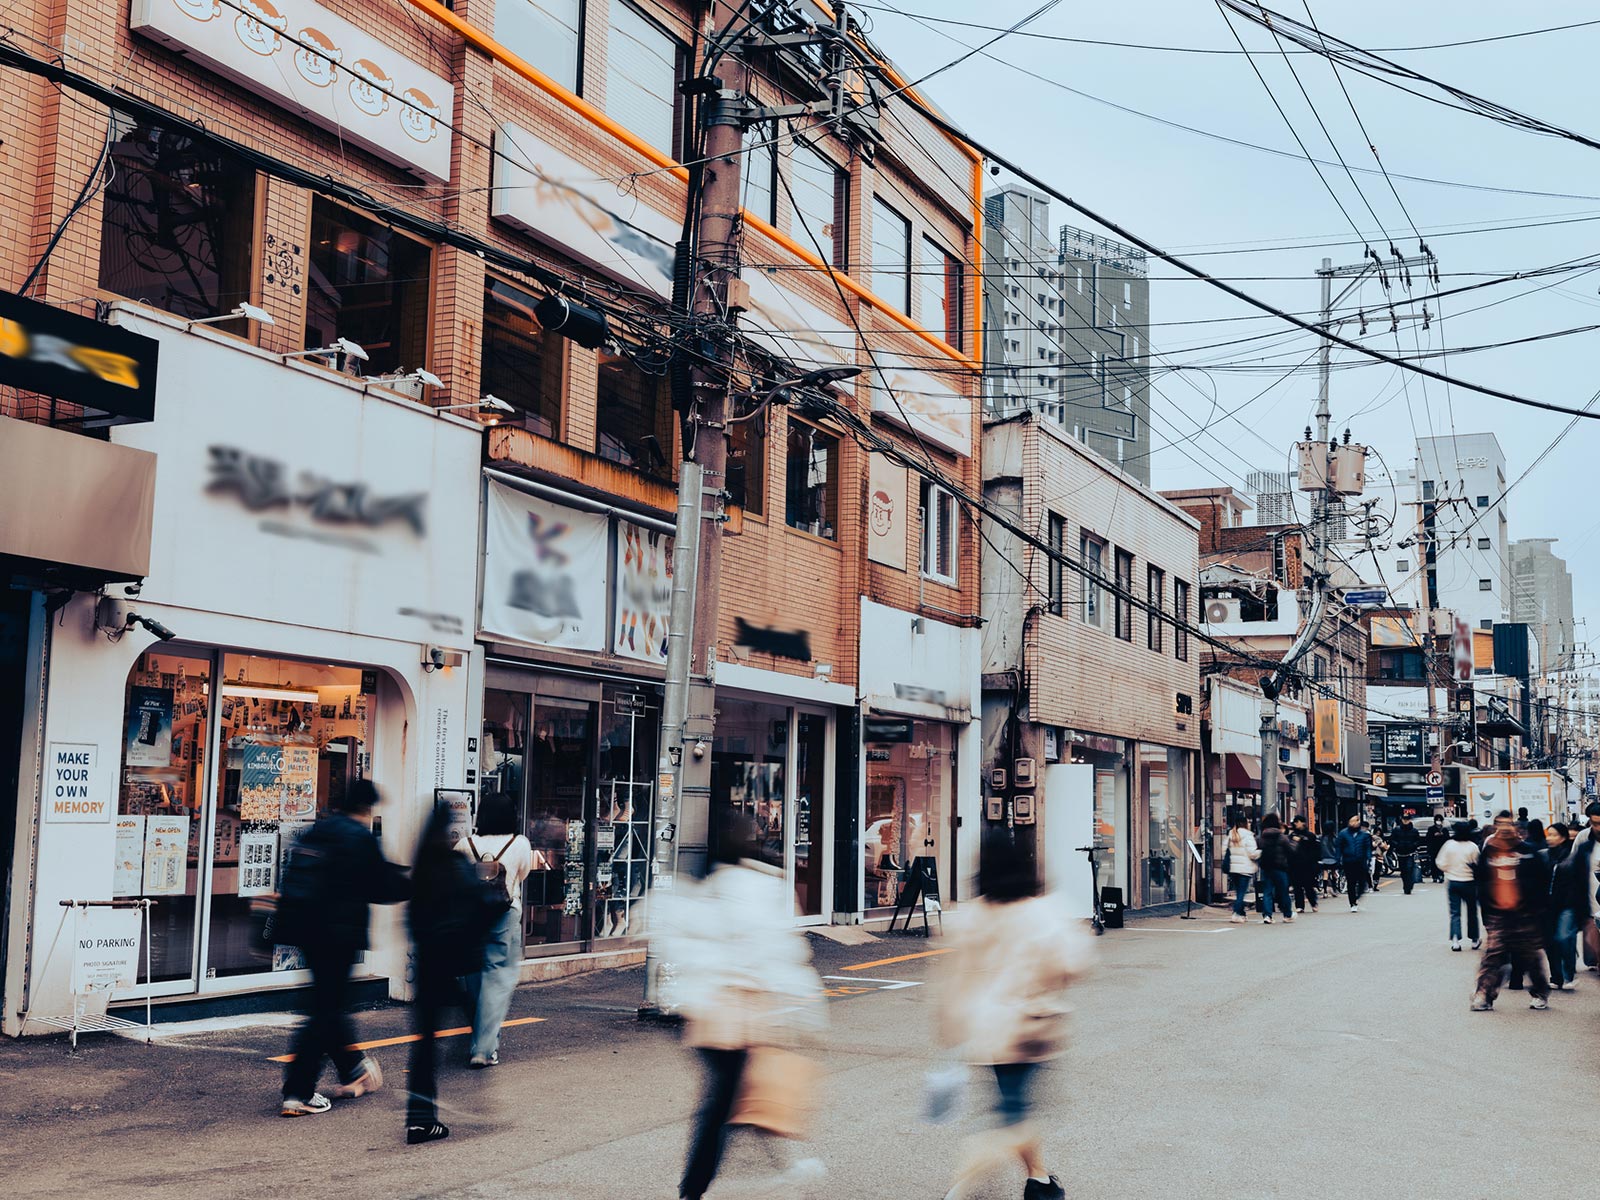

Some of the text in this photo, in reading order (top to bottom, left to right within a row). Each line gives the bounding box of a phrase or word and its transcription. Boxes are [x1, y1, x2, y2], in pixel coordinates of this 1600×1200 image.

[58, 752, 90, 764] MAKE
[56, 768, 88, 781] YOUR
[56, 786, 88, 797] OWN
[54, 802, 104, 814] MEMORY
[80, 938, 136, 948] NO PARKING
